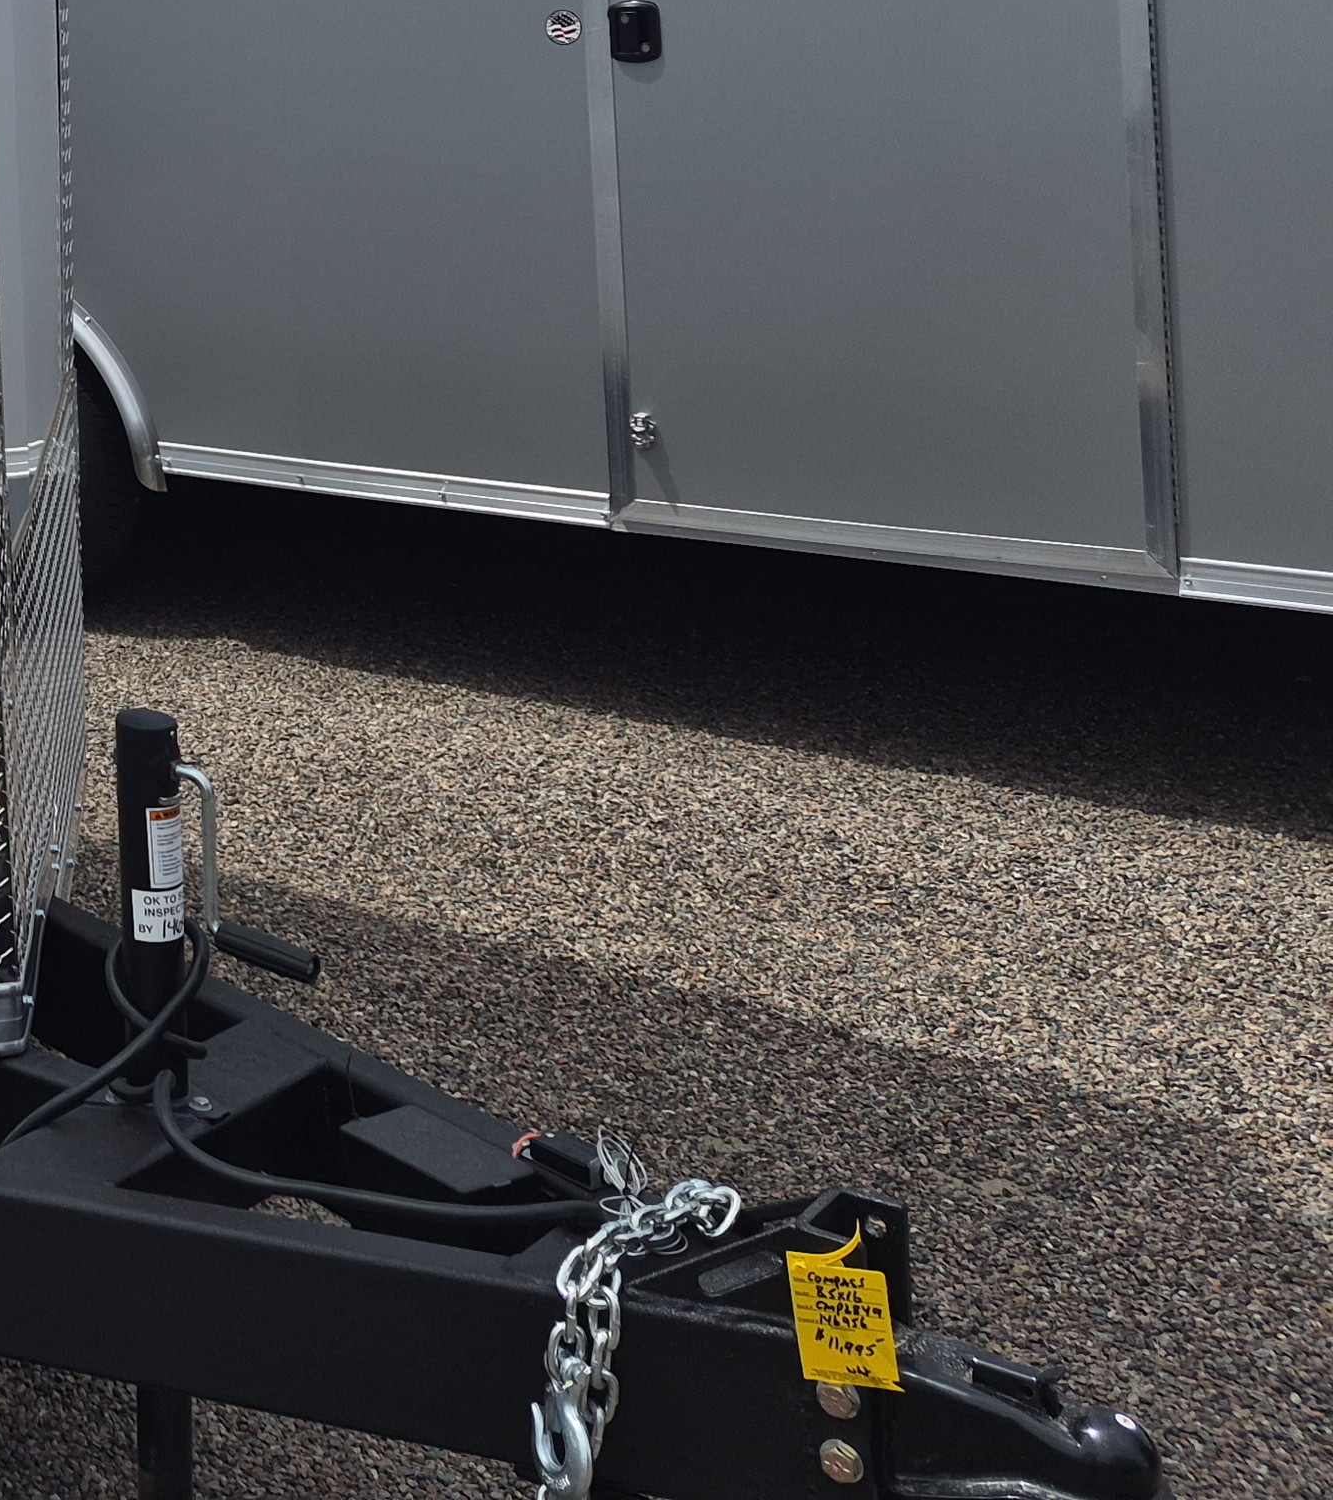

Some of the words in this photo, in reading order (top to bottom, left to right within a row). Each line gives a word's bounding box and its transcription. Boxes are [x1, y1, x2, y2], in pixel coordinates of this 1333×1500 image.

[143, 896, 161, 905] OK
[163, 894, 177, 904] TO
[138, 924, 153, 934] BY
[819, 1313, 867, 1329] 146956
